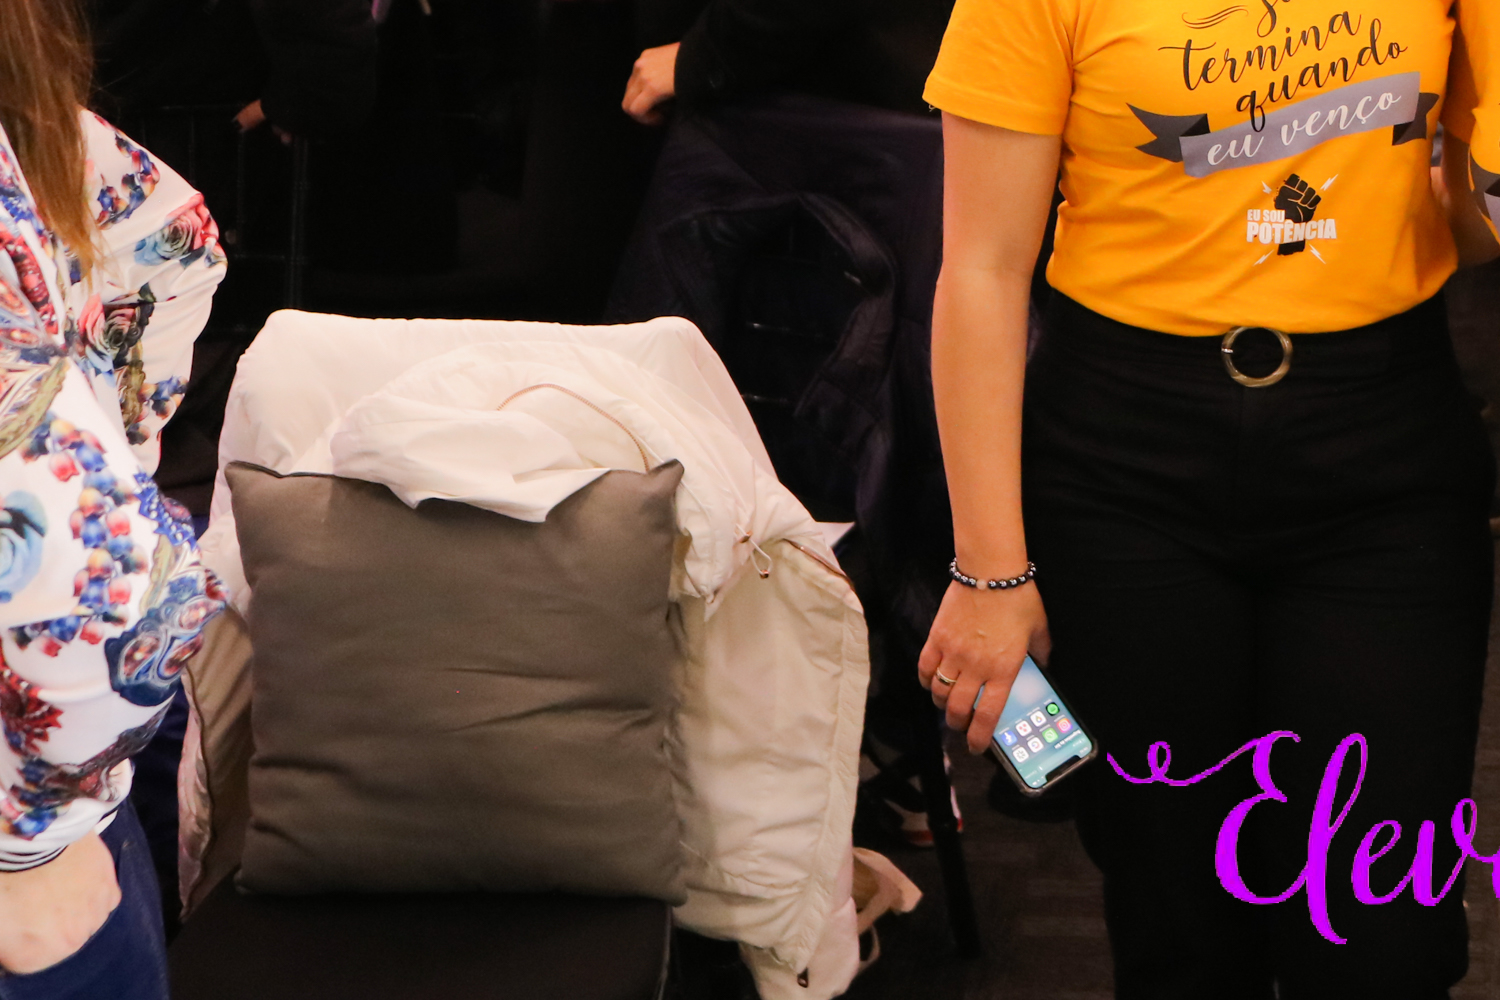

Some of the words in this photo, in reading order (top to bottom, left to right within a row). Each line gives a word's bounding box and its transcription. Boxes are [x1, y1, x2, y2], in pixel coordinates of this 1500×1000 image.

[1158, 11, 1361, 91] termina
[1236, 18, 1408, 132] quando
[1207, 134, 1264, 167] eu
[1280, 90, 1401, 146] venço
[1246, 218, 1337, 244] POTÊNCIA
[1247, 209, 1261, 221] EU
[1263, 209, 1285, 222] SOU
